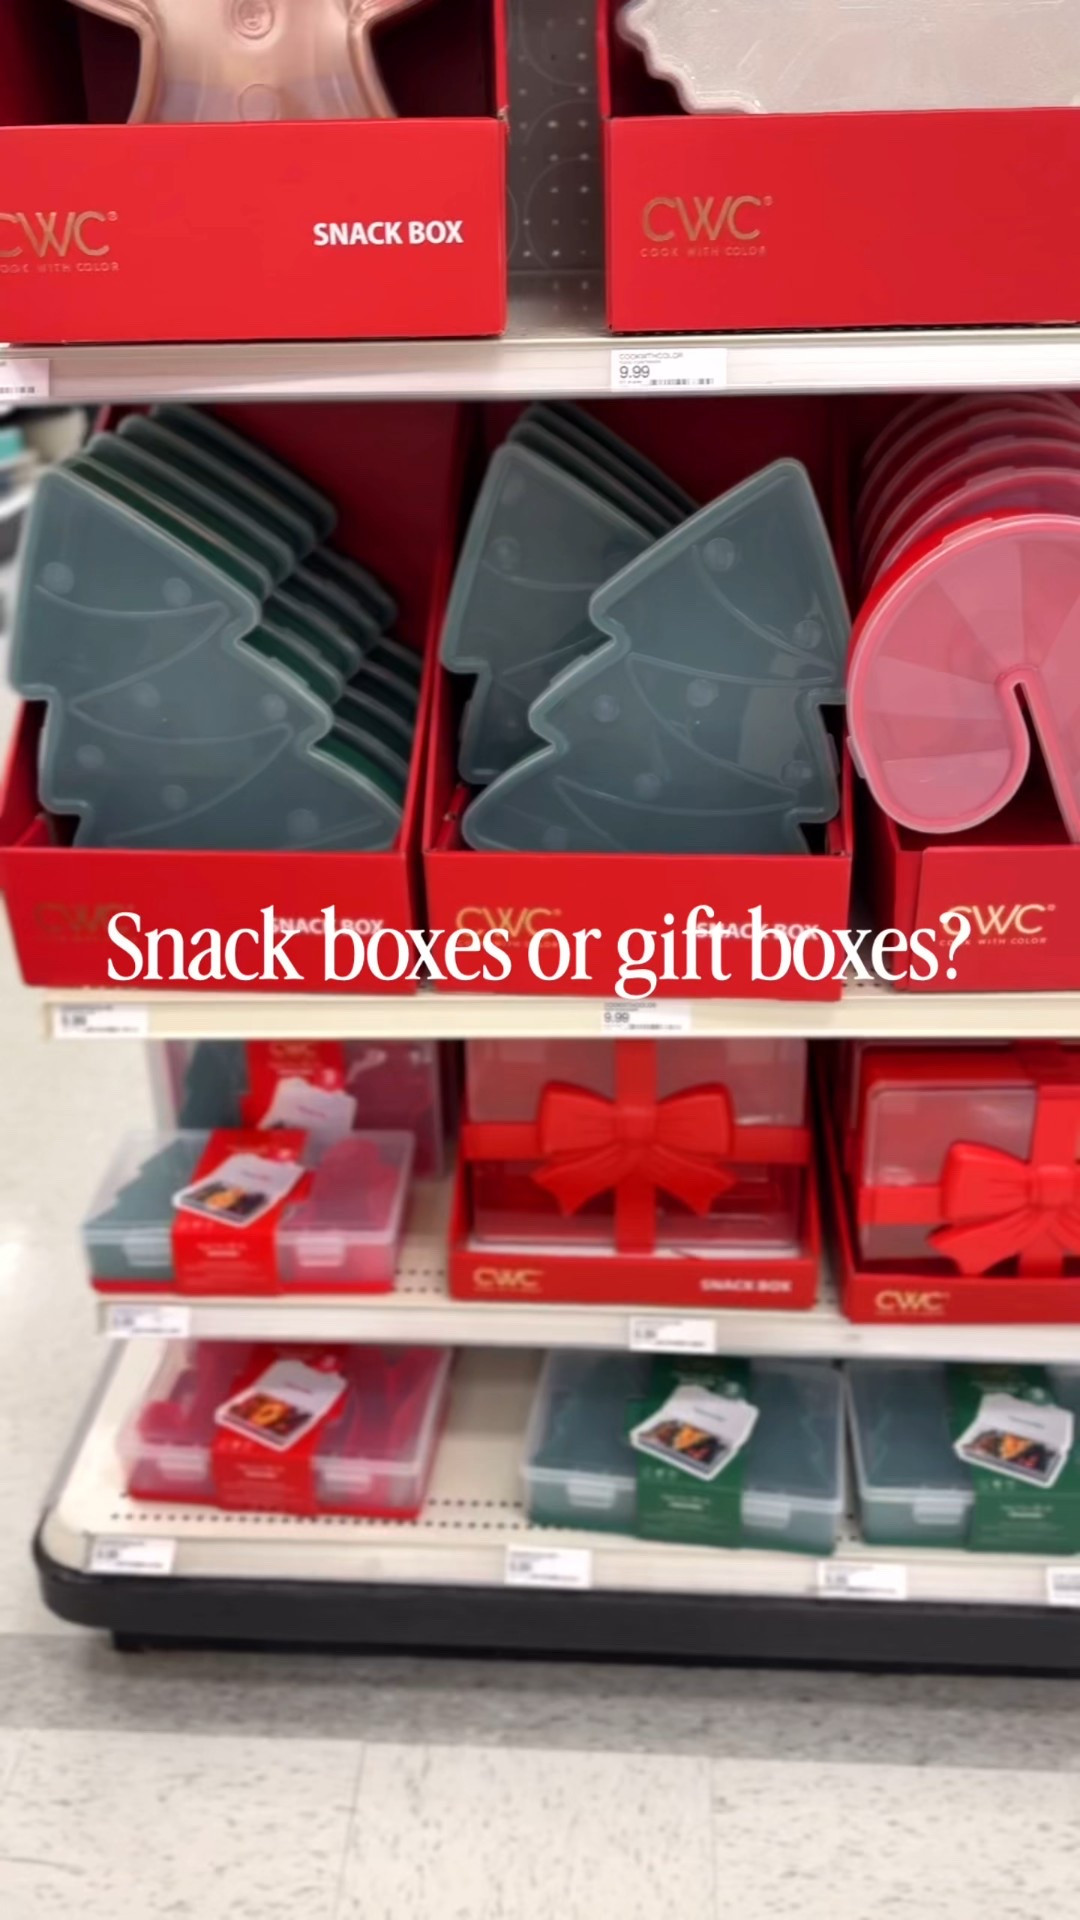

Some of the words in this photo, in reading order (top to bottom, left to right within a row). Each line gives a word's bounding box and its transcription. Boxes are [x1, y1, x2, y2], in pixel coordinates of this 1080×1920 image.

[313, 221, 403, 246] SNACK
[408, 220, 464, 245] BOX
[619, 365, 650, 379] 9.99
[271, 917, 337, 935] SNAC
